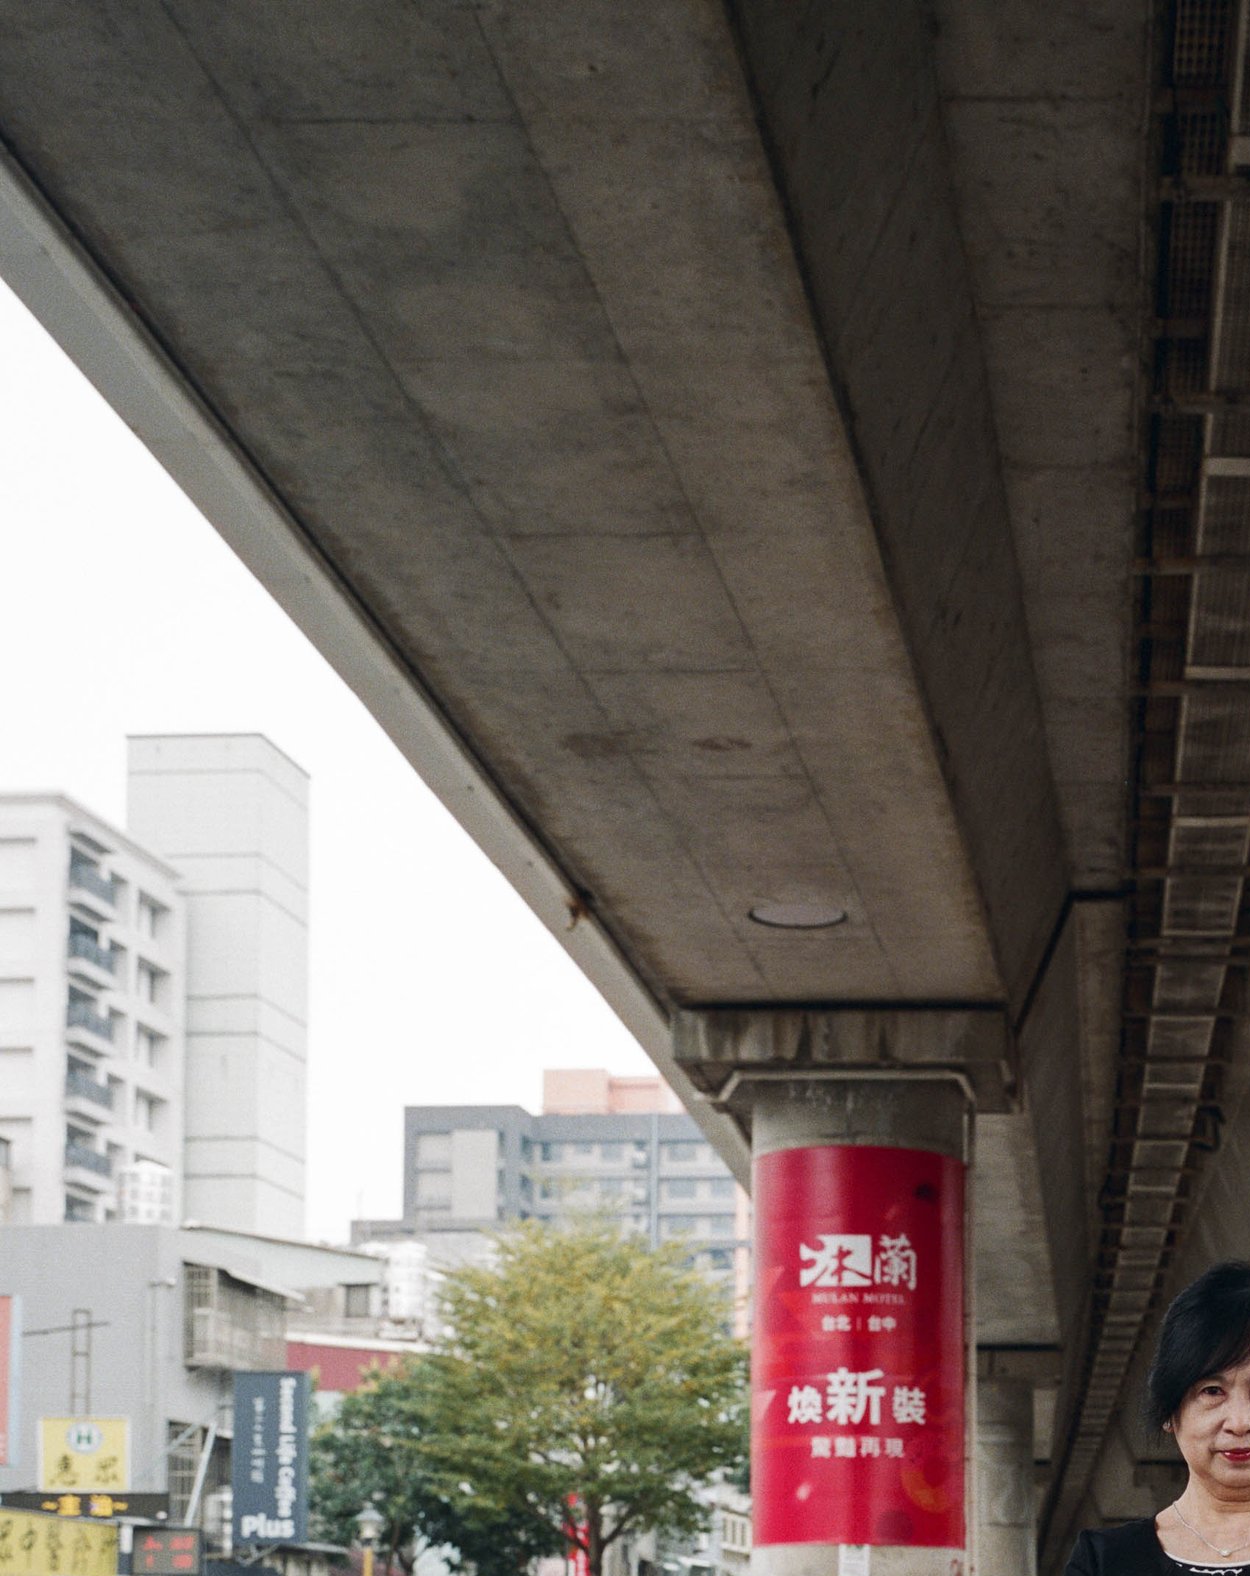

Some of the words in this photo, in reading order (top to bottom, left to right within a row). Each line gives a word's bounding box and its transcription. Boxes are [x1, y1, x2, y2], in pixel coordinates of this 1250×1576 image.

[812, 1292, 859, 1305] MULAN
[863, 1292, 905, 1306] MOTEL
[241, 1512, 296, 1538] Plus
